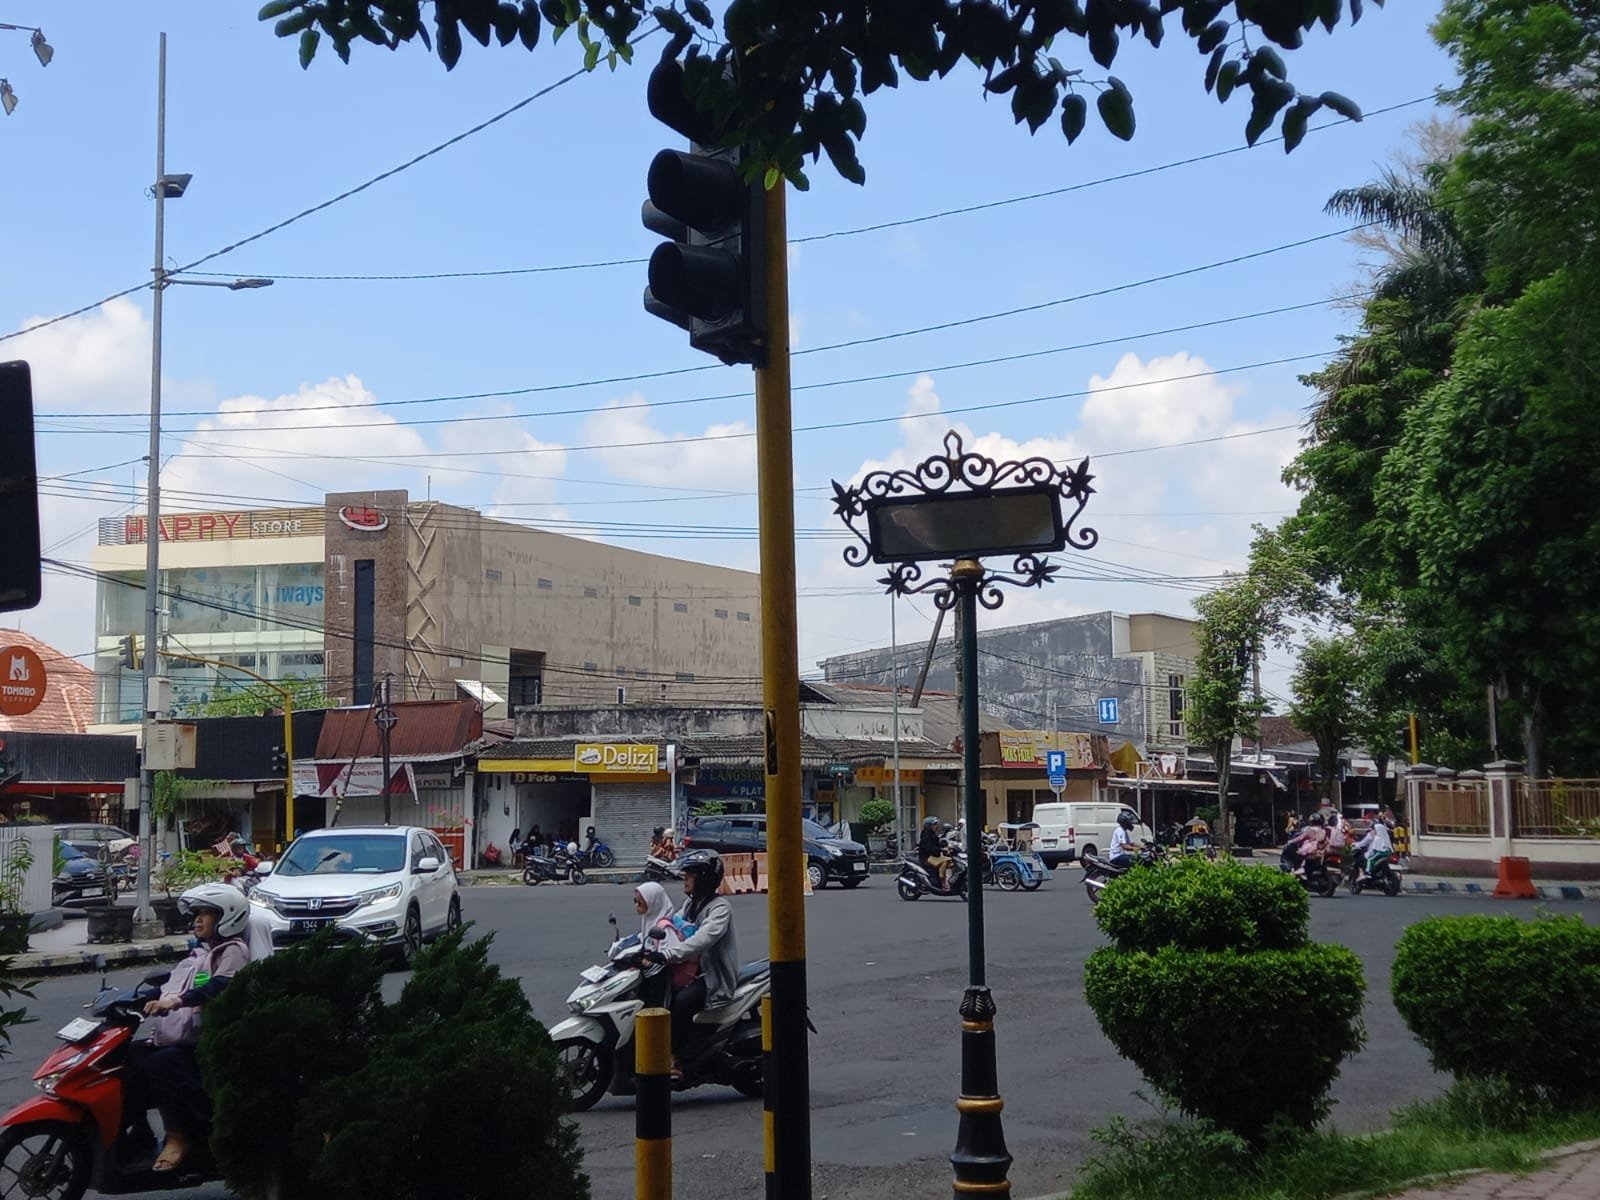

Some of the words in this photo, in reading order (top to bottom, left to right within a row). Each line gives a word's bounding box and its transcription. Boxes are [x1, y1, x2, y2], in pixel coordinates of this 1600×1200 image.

[125, 513, 241, 544] HAPPY
[252, 519, 302, 533] STORE
[2, 686, 36, 697] TOMORO
[603, 746, 654, 766] Delizi
[1050, 754, 1062, 772] P
[528, 773, 557, 783] Foto
[741, 786, 762, 796] PLAT
